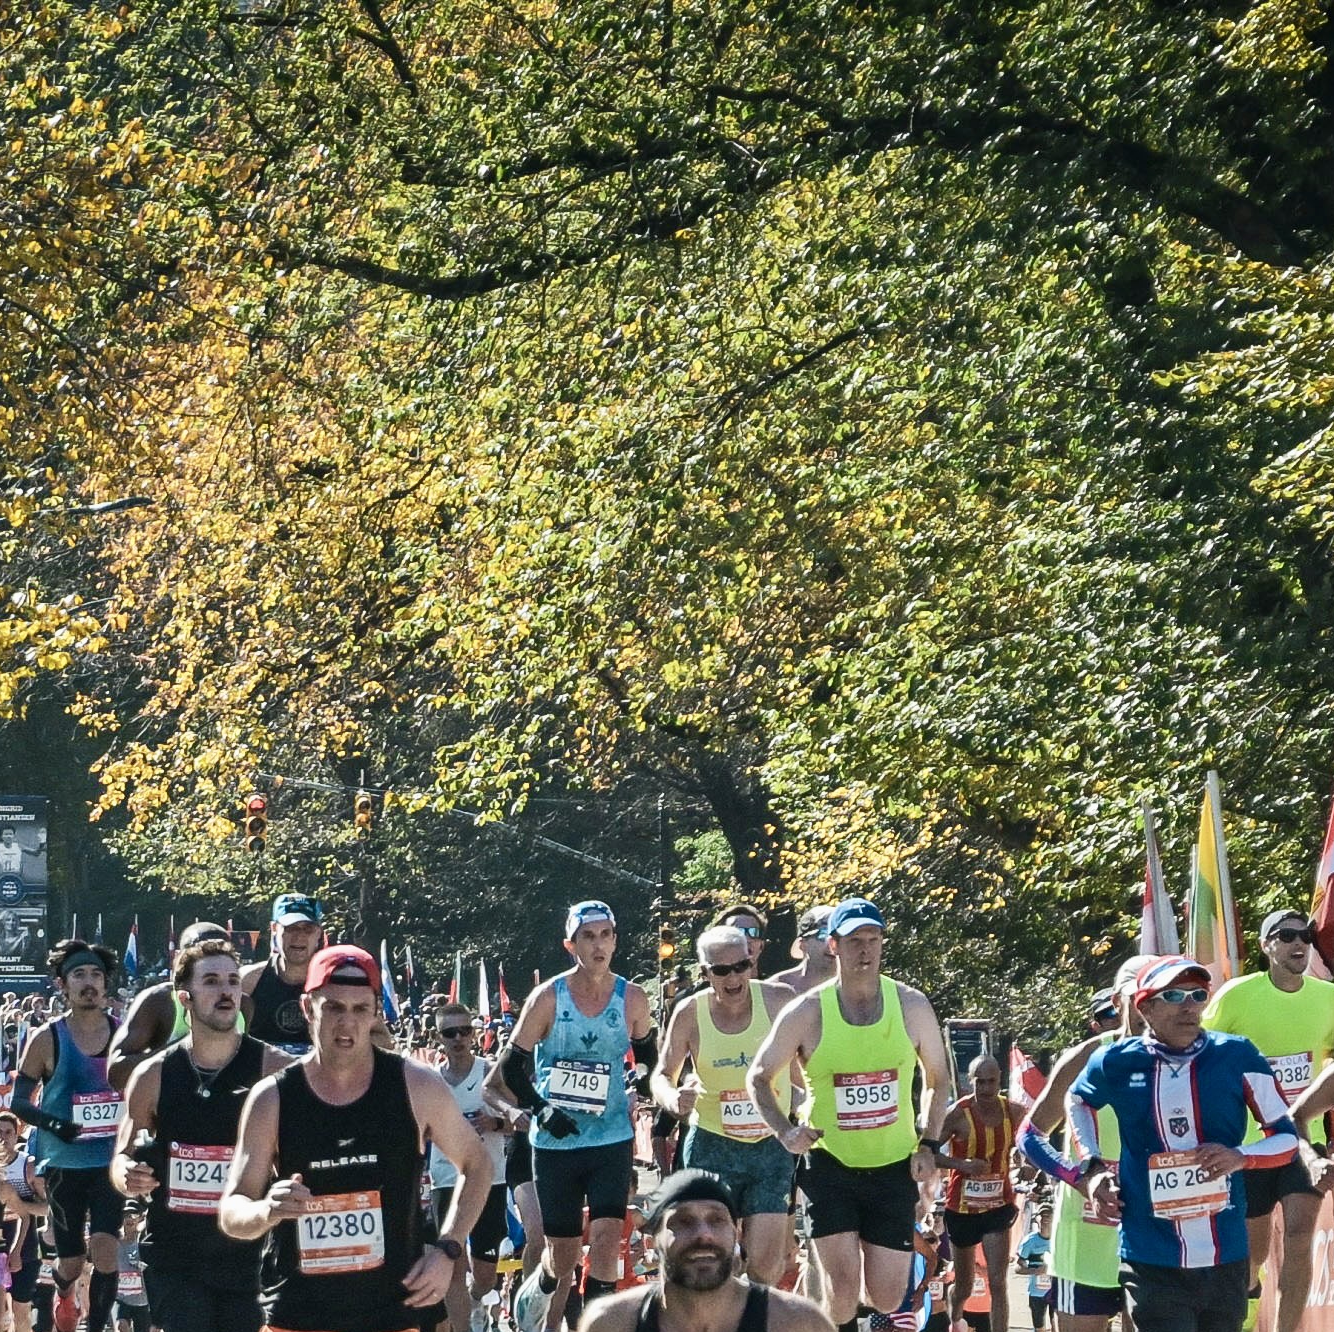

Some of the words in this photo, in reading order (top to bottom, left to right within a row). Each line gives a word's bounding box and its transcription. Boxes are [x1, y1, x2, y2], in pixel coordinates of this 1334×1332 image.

[561, 1071, 599, 1092] 7149
[845, 1084, 891, 1106] 5958
[82, 1103, 119, 1121] 6327
[723, 1104, 743, 1116] AG
[310, 1154, 378, 1169] RELEASE
[965, 1181, 981, 1193] AG
[982, 1181, 1003, 1193] 1877
[1154, 1171, 1179, 1191] AG
[304, 1211, 376, 1240] 12380
